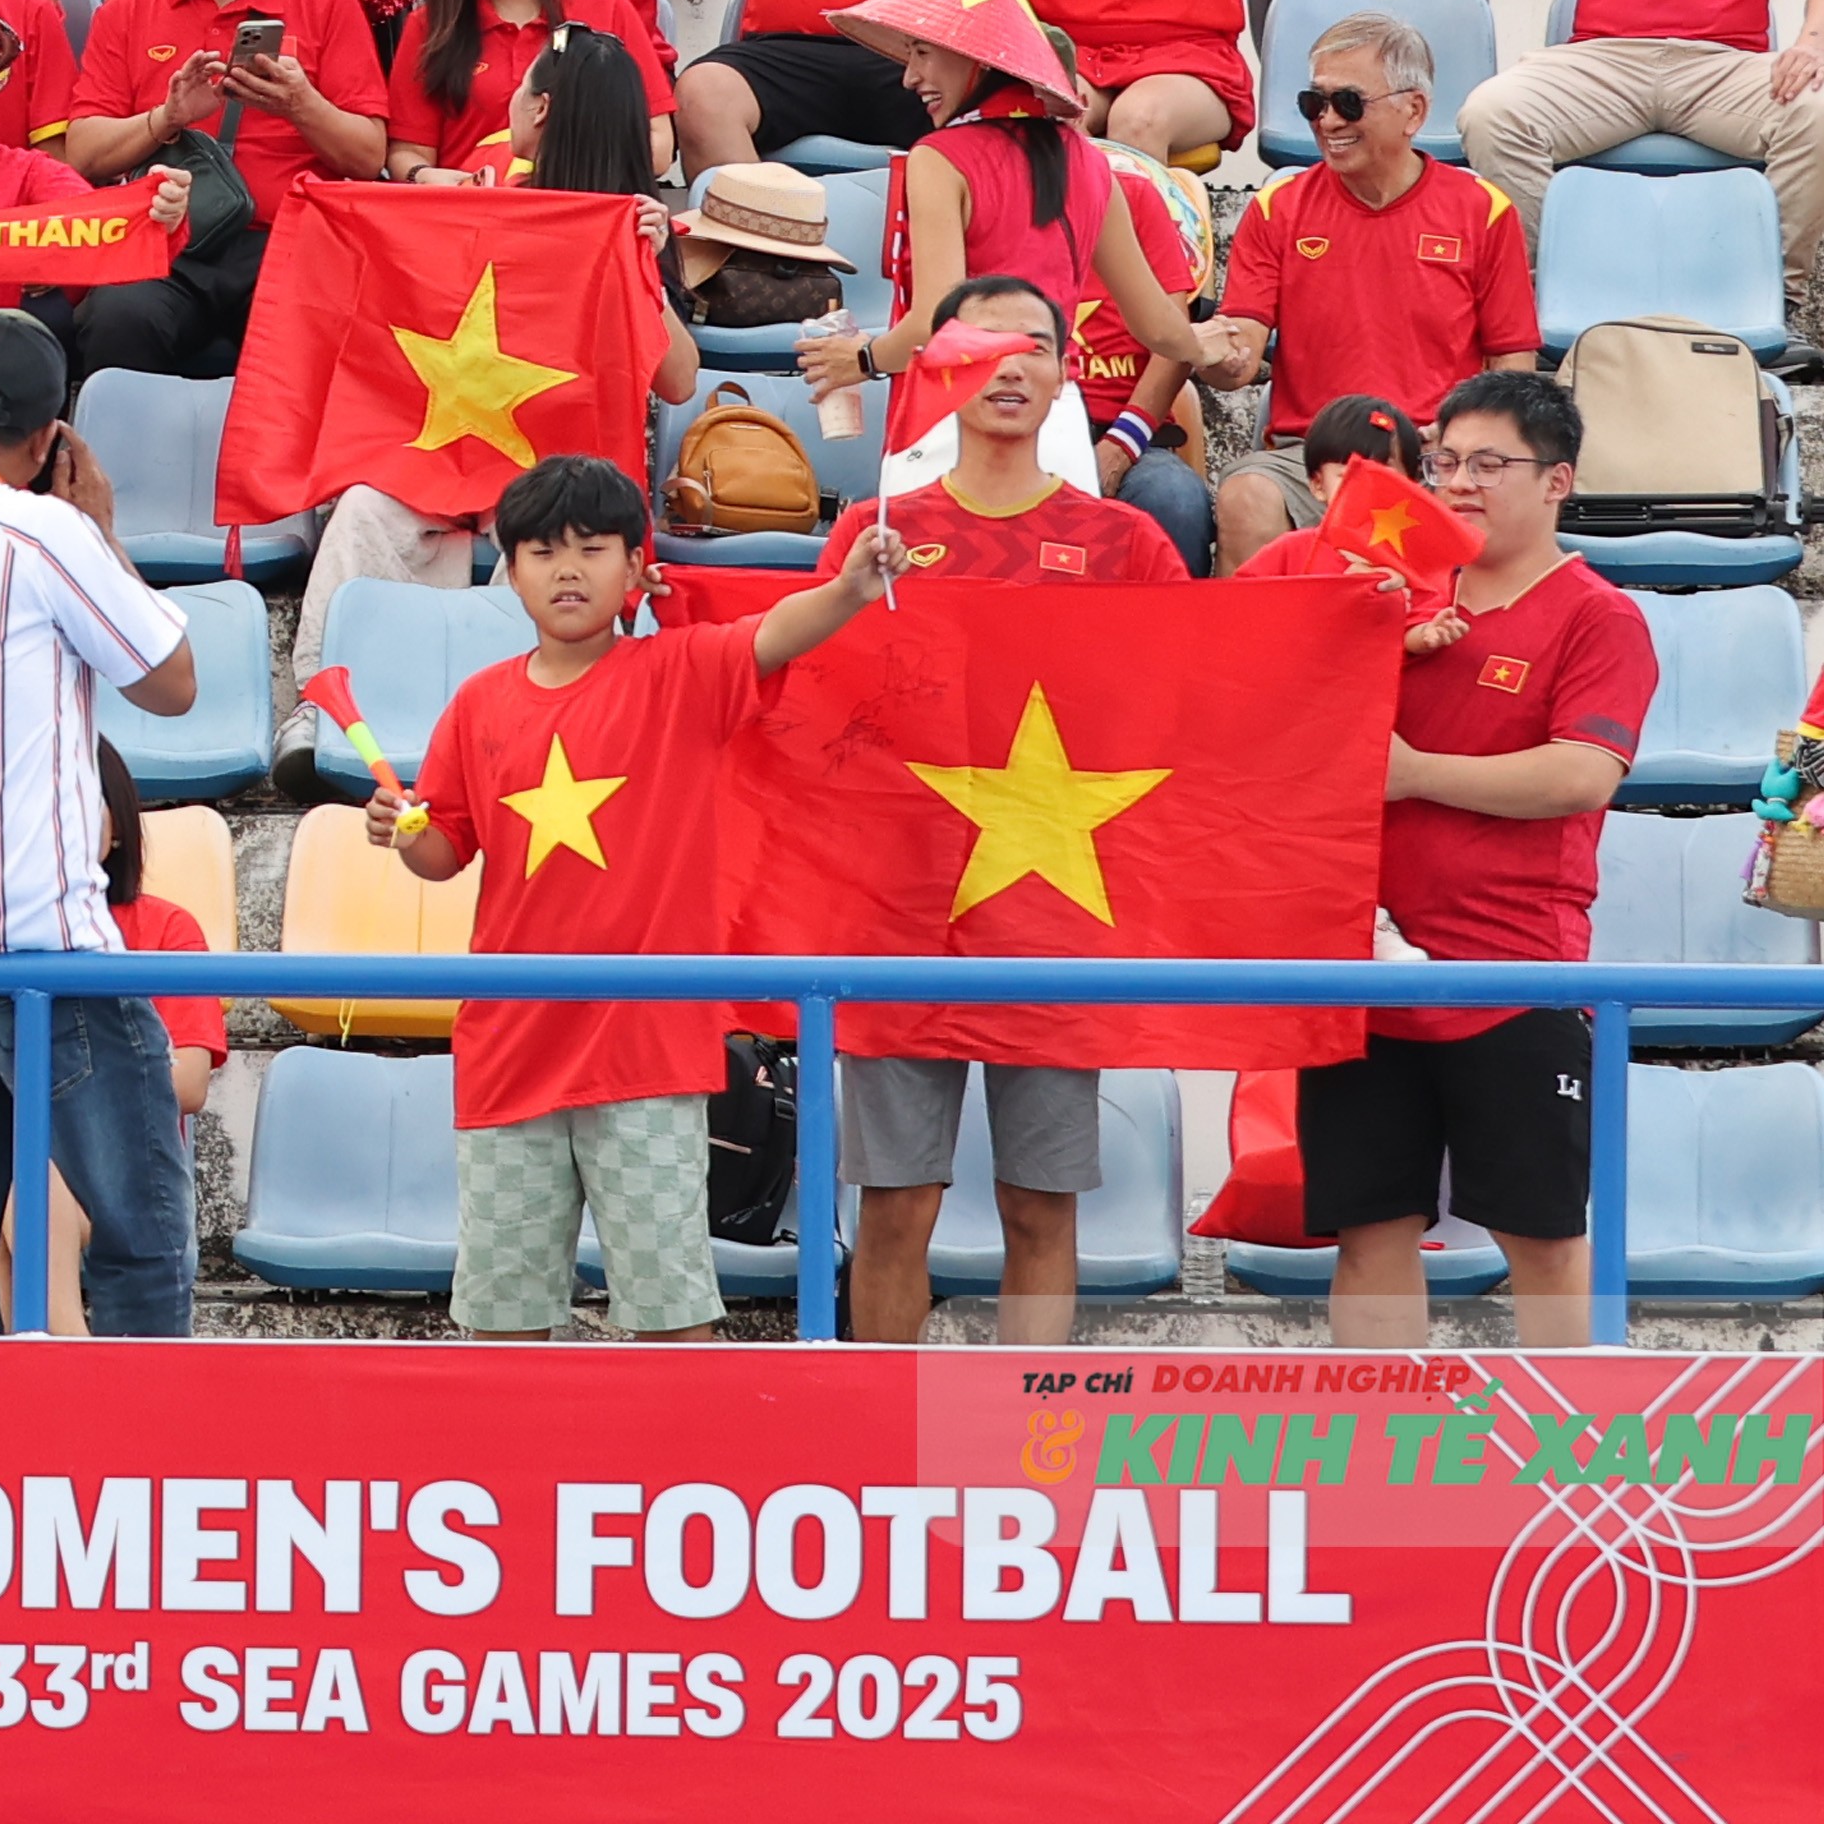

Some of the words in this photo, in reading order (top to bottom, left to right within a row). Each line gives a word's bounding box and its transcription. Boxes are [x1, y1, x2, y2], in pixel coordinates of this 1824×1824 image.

[554, 1481, 1352, 1625] FOOTBALL
[179, 1645, 369, 1735] SEA
[398, 1649, 746, 1739] GAMES
[775, 1653, 1023, 1741] 2025
